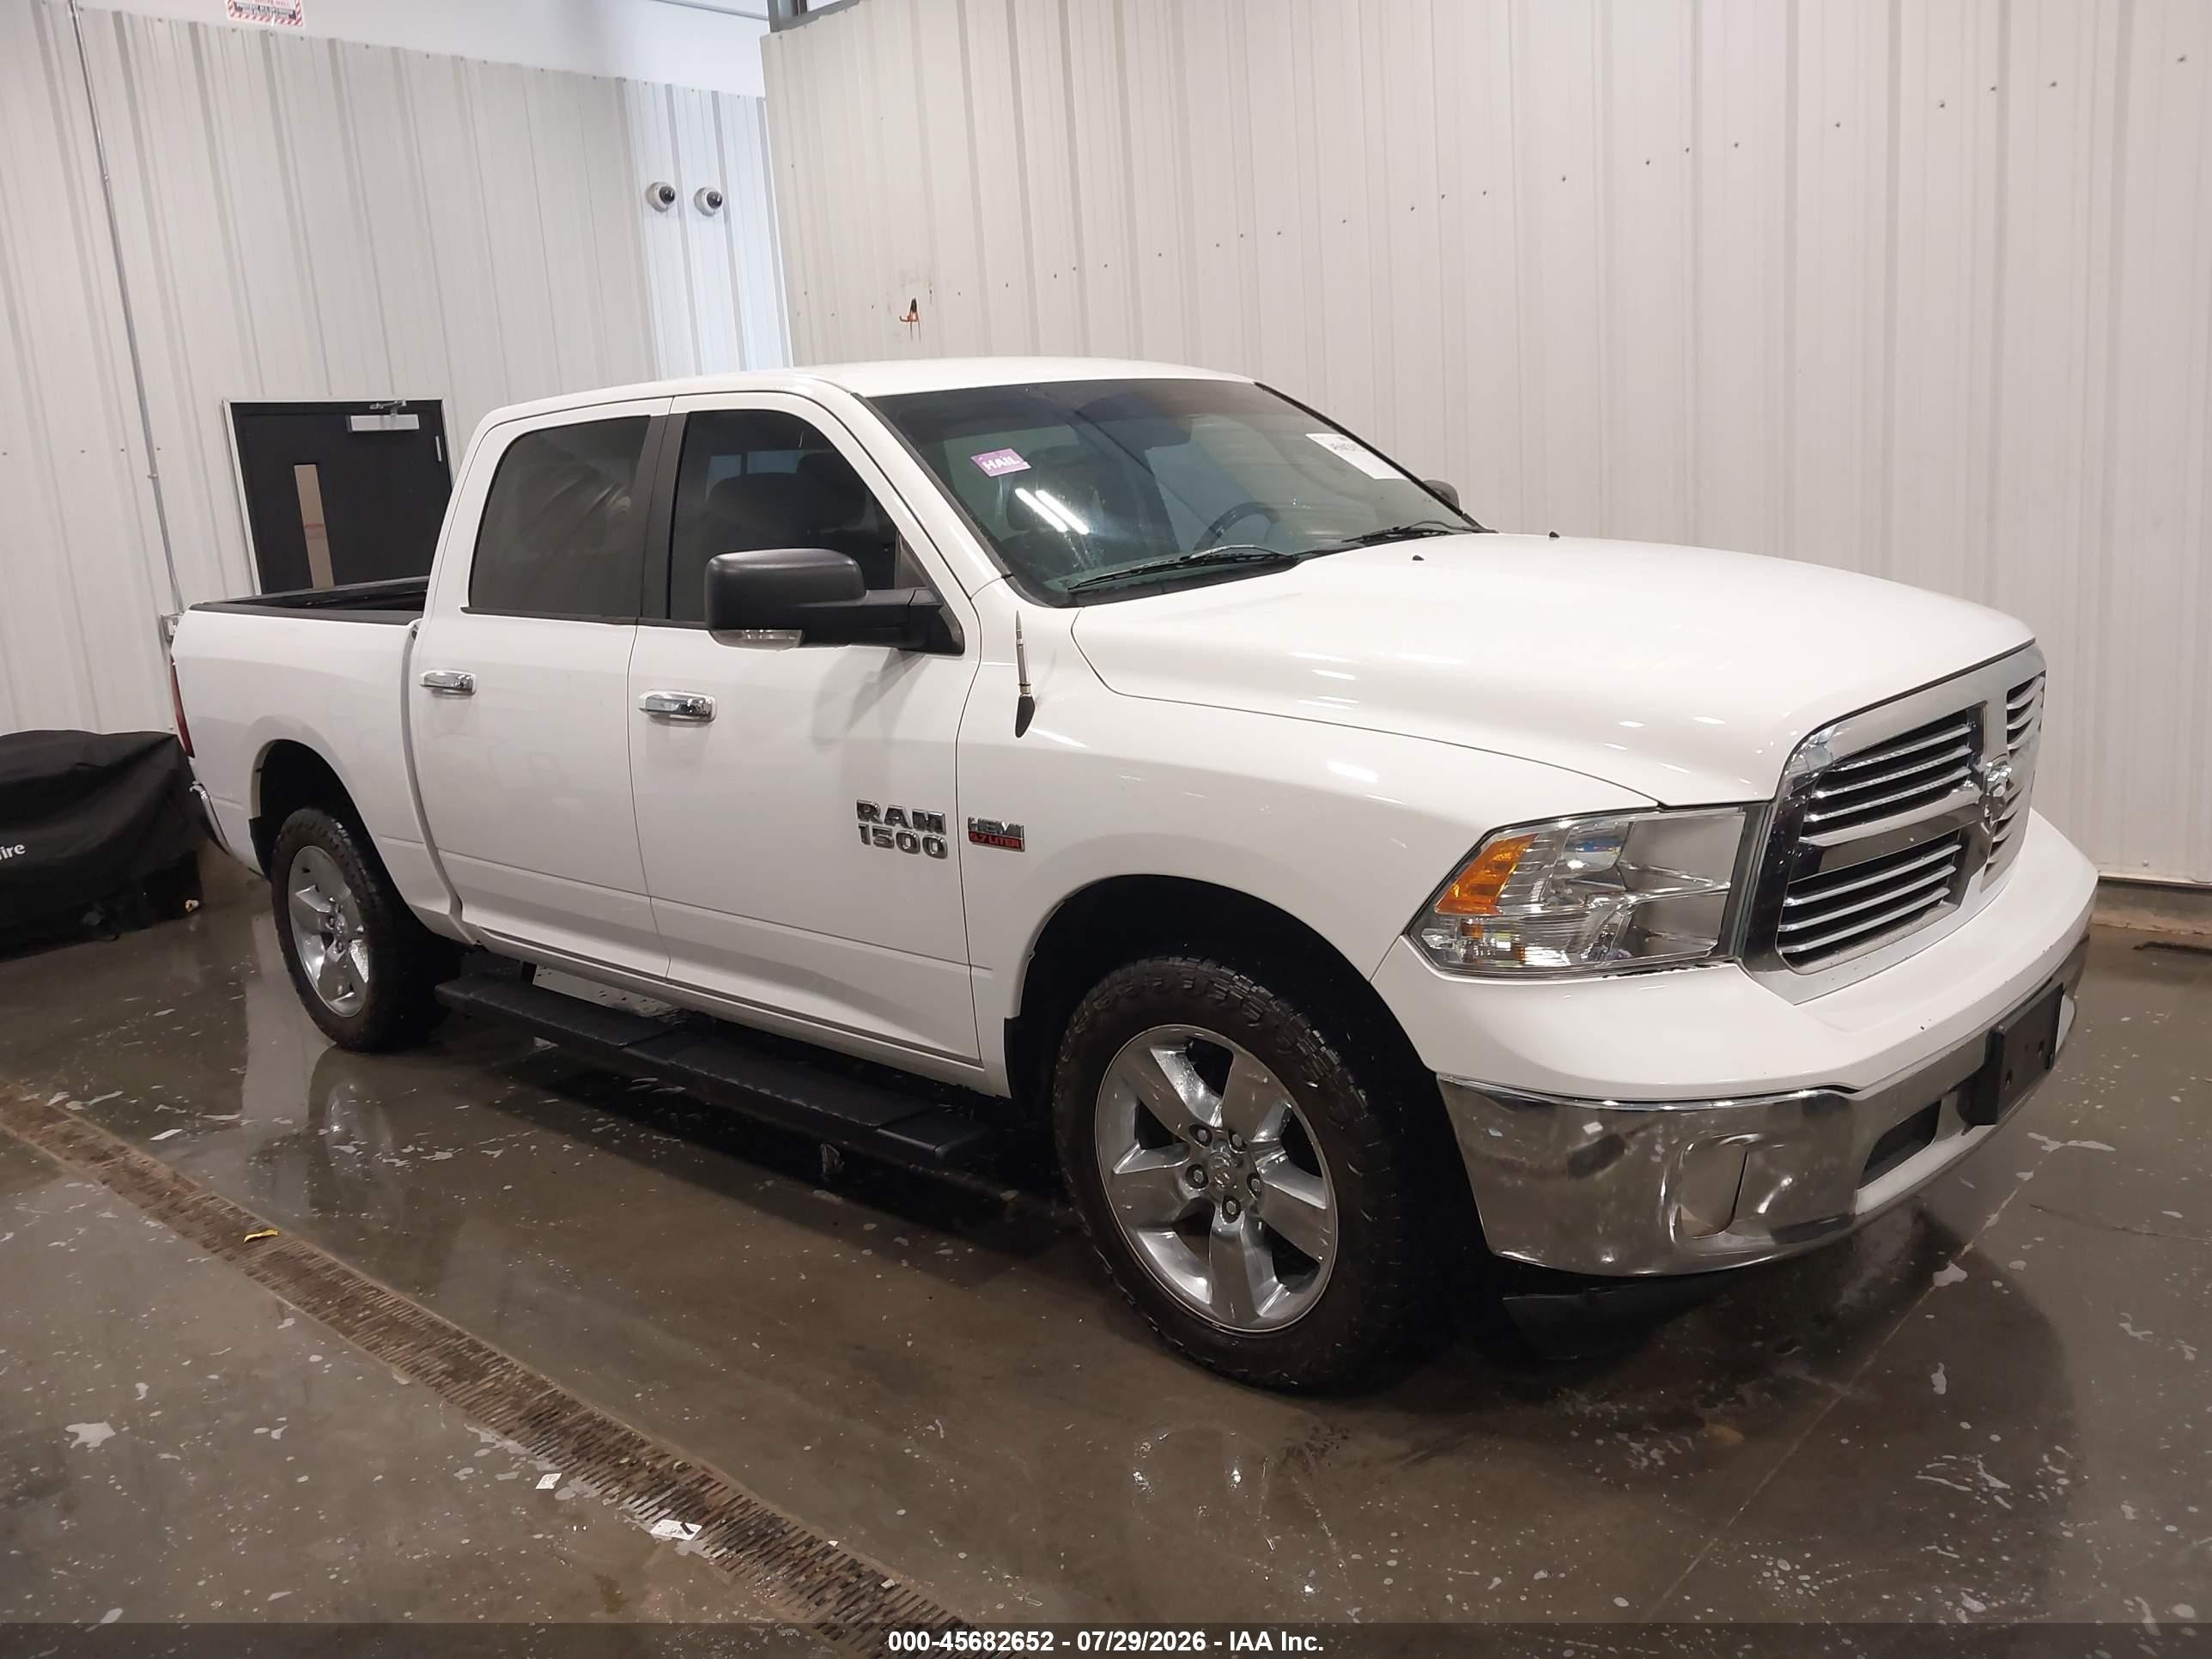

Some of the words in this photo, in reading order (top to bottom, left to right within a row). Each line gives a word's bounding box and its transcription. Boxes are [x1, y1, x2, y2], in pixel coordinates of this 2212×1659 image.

[982, 456, 1020, 471] HAIL
[856, 799, 947, 835] RAM
[968, 817, 1024, 839] HEMI
[858, 823, 948, 860] 1500
[988, 836, 1020, 848] LITER
